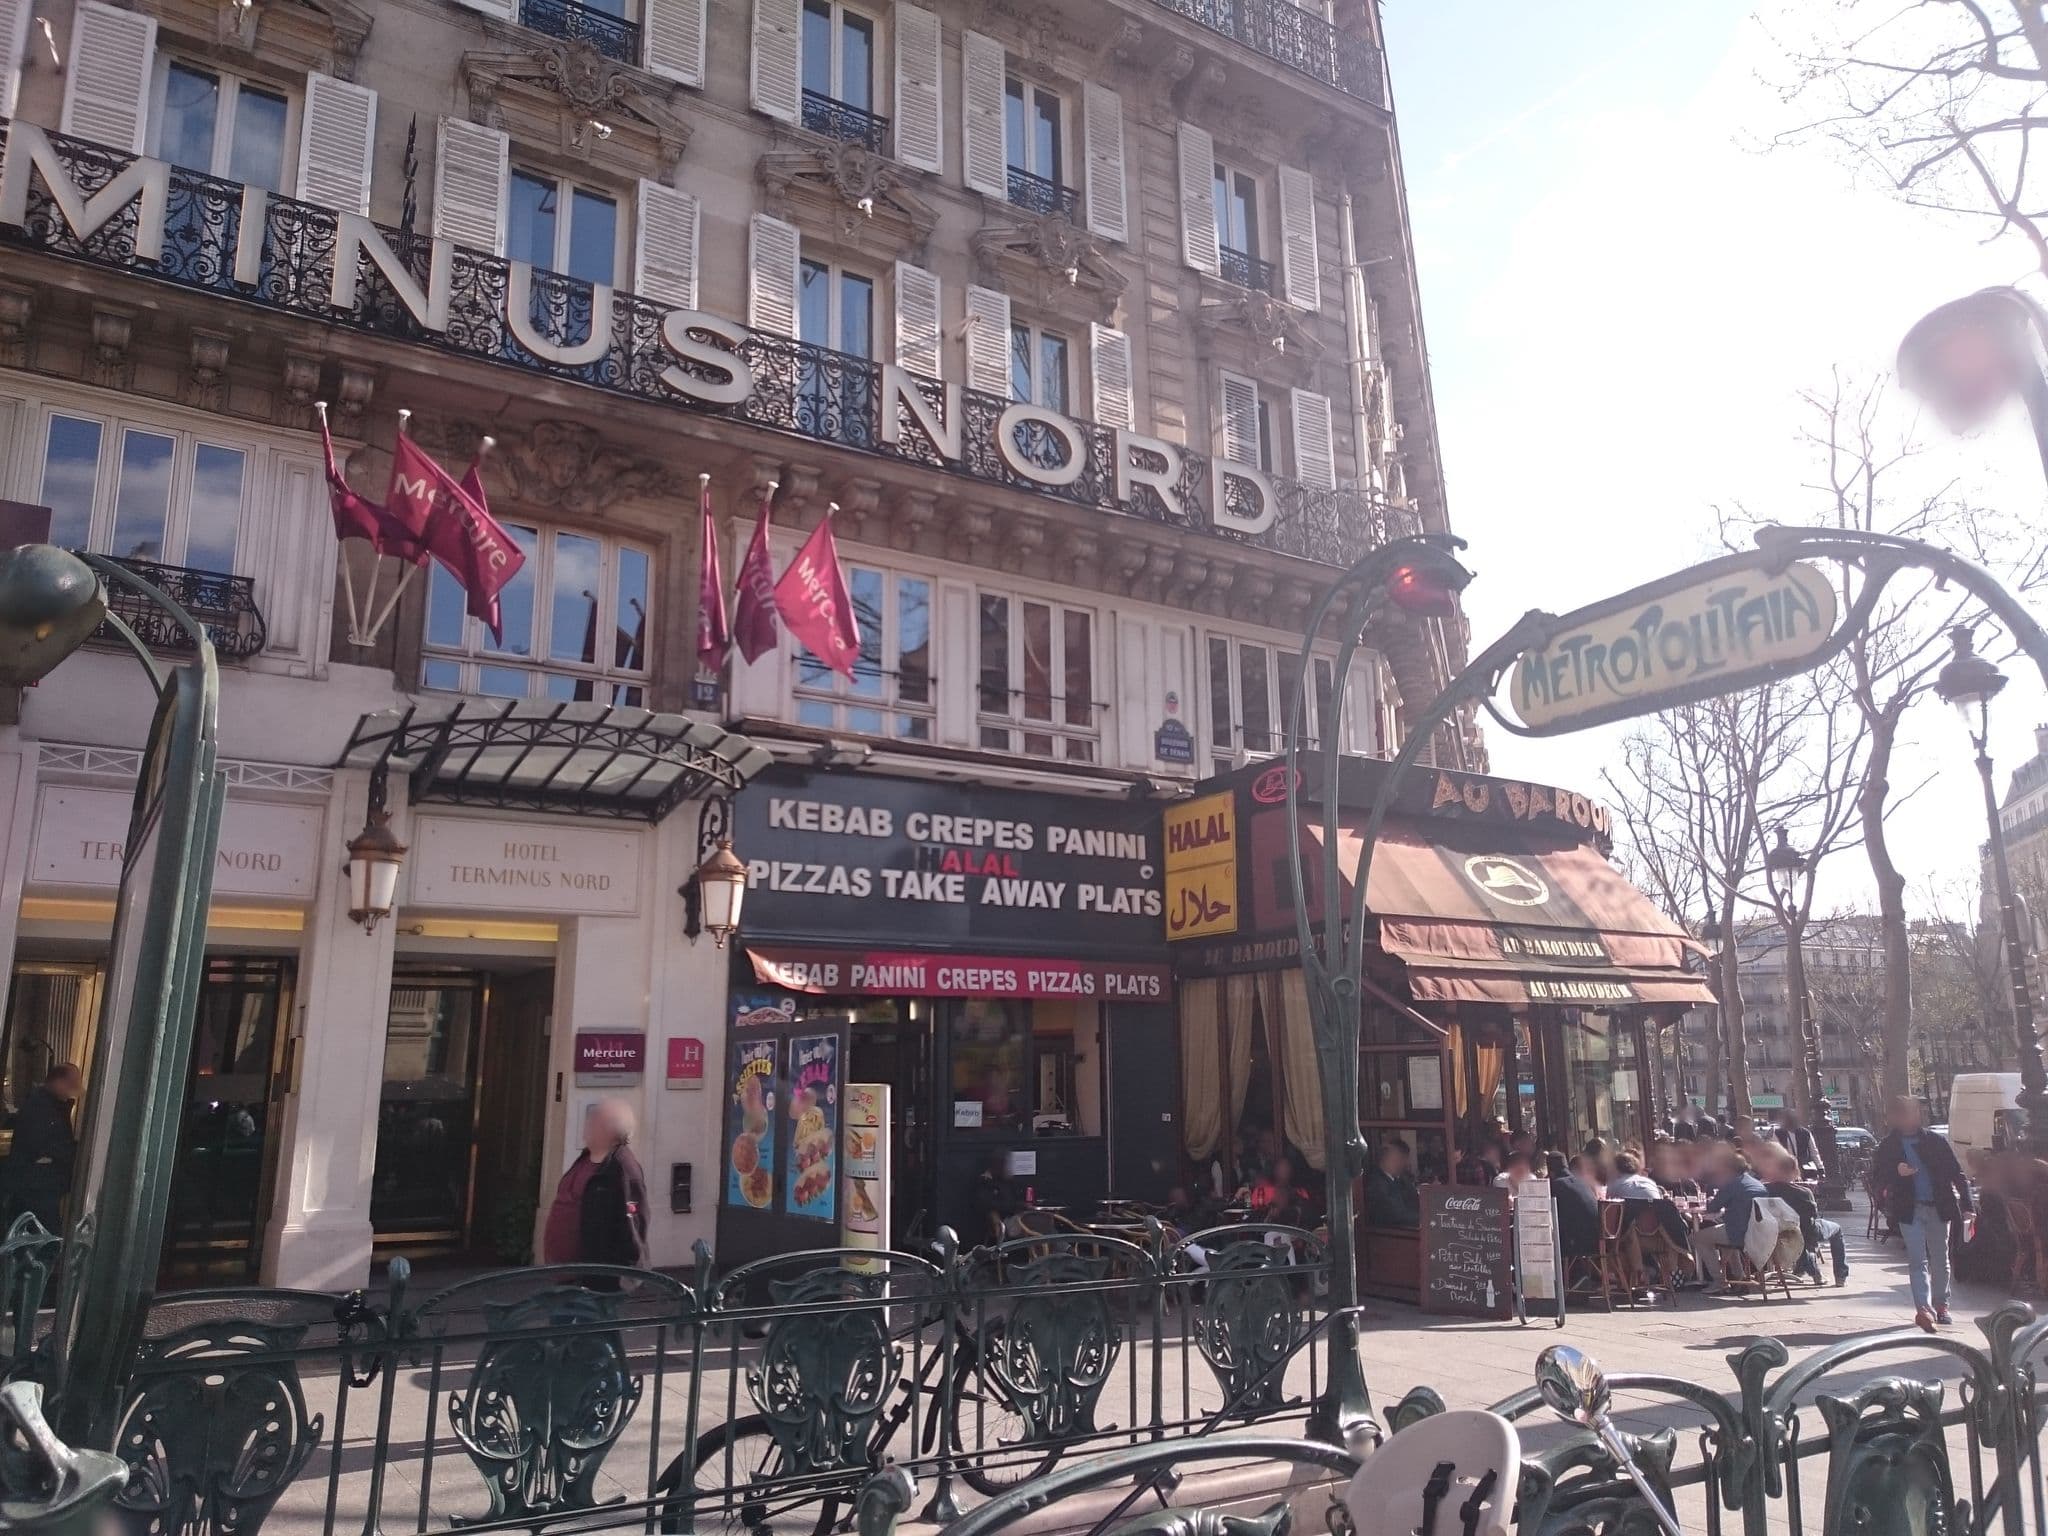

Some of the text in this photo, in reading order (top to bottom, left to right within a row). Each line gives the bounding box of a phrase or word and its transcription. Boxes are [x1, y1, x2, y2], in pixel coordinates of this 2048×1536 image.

[881, 363, 1278, 535] NORD
[1521, 584, 1821, 711] METROPOLITAIN
[1433, 771, 1491, 813] AU
[769, 798, 1146, 860] KEBAB CREPES PANINI
[1168, 812, 1230, 854] HALAL
[217, 850, 281, 872] NORD
[504, 842, 560, 862] HOTEL
[450, 865, 610, 891] TERMINUS NORD
[748, 859, 1162, 916] PIZZAS TAKE AWAY PLATS
[1170, 883, 1231, 931] حلال
[1503, 937, 1605, 957] AU BAROUDEUR
[762, 960, 1160, 996] KEBAB PANINI CREPES PIZZAS PLATS
[1530, 981, 1633, 999] AU BAROUDEUR
[583, 1048, 636, 1058] Mercure
